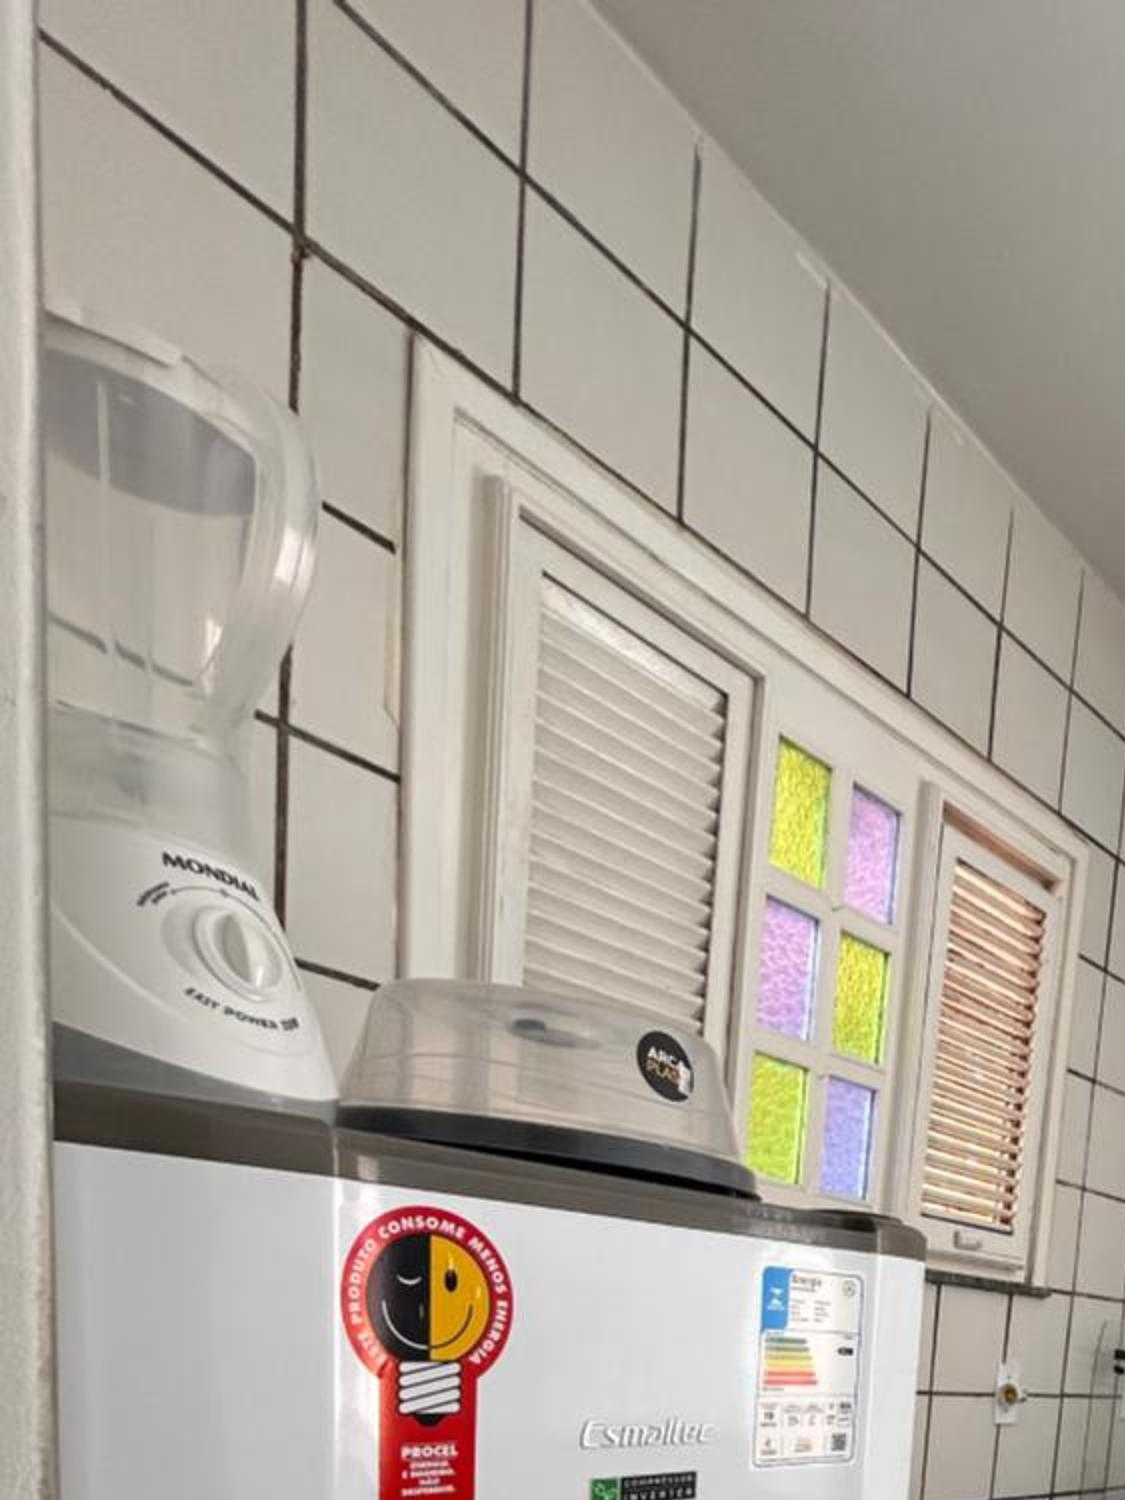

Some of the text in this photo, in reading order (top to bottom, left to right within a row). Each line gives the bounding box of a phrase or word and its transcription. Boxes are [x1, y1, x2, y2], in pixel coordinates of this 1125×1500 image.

[162, 852, 259, 901] MONDIAL
[223, 1005, 278, 1029] POWER
[378, 1216, 465, 1240] CONSOME
[348, 1239, 376, 1325] PRODUTO
[468, 1237, 508, 1294] MENOS
[469, 1300, 509, 1364] ENERGIA
[401, 1444, 458, 1459] PROCEL
[579, 1418, 714, 1450] Esmaltec
